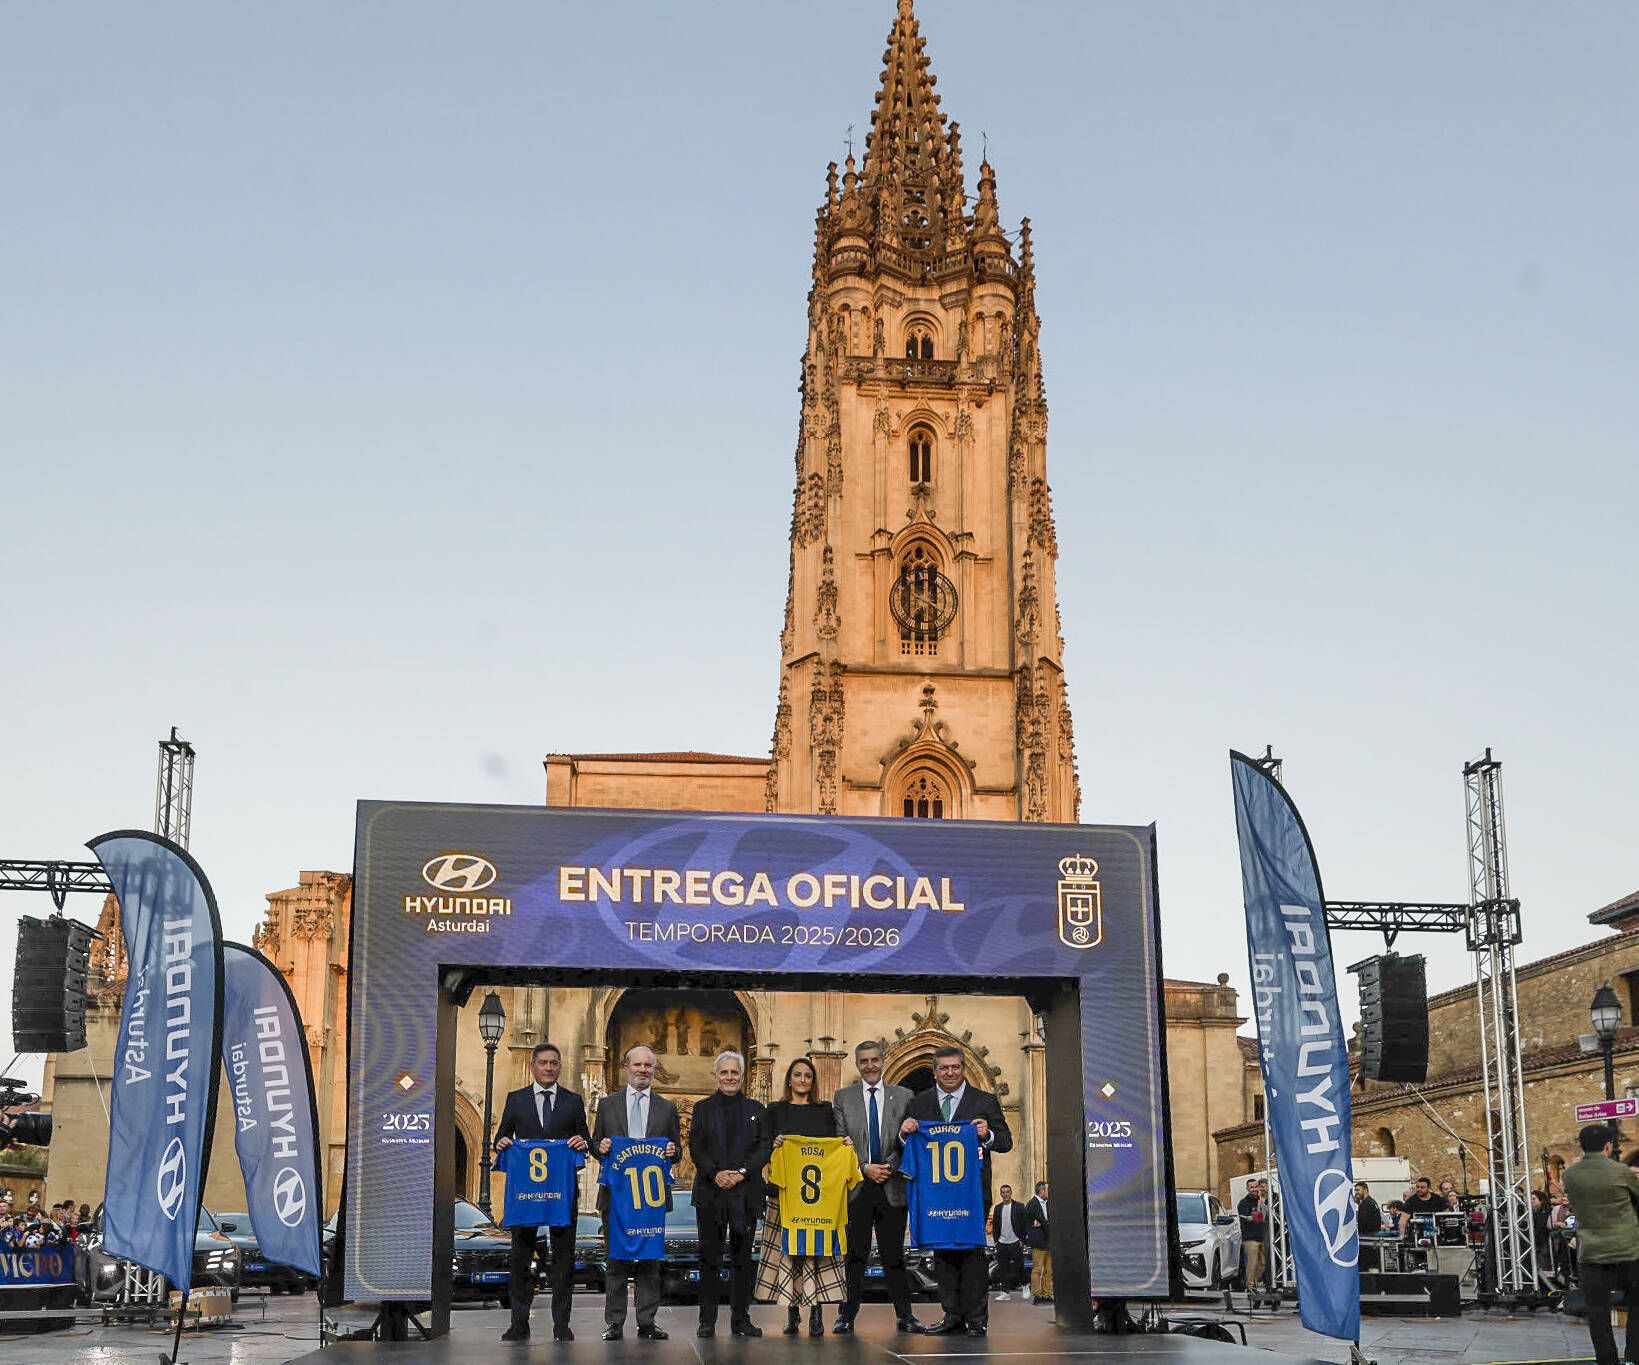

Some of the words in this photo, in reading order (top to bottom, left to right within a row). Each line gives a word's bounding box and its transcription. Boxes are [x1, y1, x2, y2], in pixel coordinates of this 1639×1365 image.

[560, 866, 779, 907] ENTREGA
[786, 872, 965, 911] OFICIAL
[405, 896, 511, 915] HYUNDAI
[427, 919, 490, 933] Asturdai
[625, 921, 776, 945] TEMPORADA
[781, 926, 900, 947] 2025/2026
[382, 1113, 430, 1130] 2025
[1088, 1121, 1132, 1138] 2025
[529, 1147, 548, 1183] 8
[801, 1147, 825, 1158] ROSA
[926, 1141, 965, 1184] 10
[624, 1165, 666, 1210] 10
[800, 1164, 822, 1206] 8
